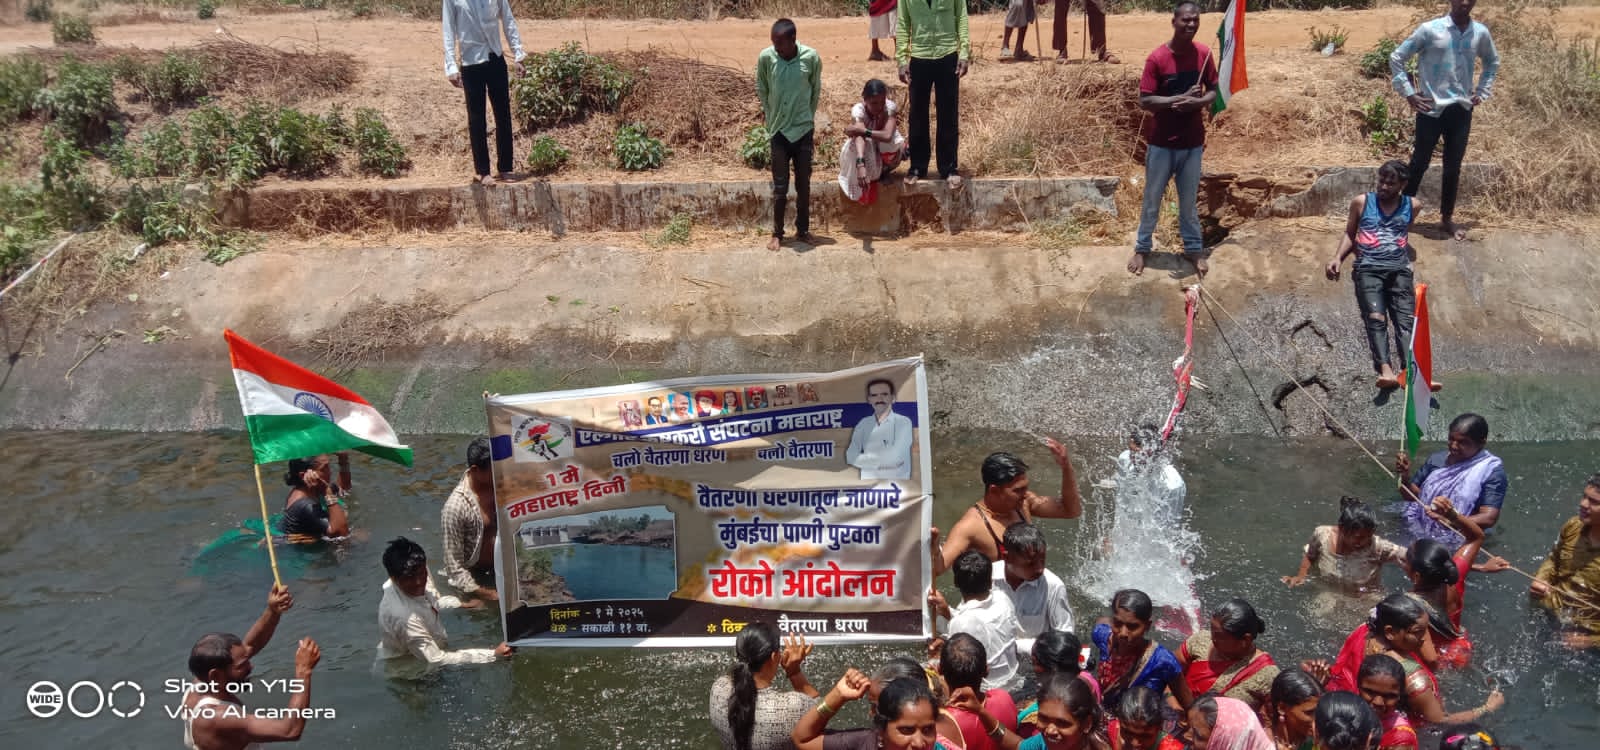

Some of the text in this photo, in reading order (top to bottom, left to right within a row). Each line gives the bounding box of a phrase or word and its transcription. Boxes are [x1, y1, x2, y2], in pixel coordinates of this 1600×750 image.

[707, 418, 772, 442] संघटना
[775, 409, 843, 429] महाराष्ट्र
[612, 446, 725, 467] चलो वैतरणा धरण
[758, 439, 833, 459] चलो वैतरणा
[560, 465, 579, 484] मे
[507, 475, 625, 518] महाराष्ट्र दिनी
[697, 484, 757, 508] वैतरणा
[843, 483, 902, 508] जाणारे
[719, 517, 881, 550] मुंबईचा पाणी पुरवठा
[709, 560, 896, 598] रोको आंदोलन
[550, 607, 580, 620] दिनांक
[605, 604, 614, 616] मे
[618, 607, 644, 618] २०२५
[581, 621, 614, 632] सकाळी
[619, 622, 632, 634] ११
[777, 613, 829, 633] वैतरणा
[835, 618, 868, 632] धरण
